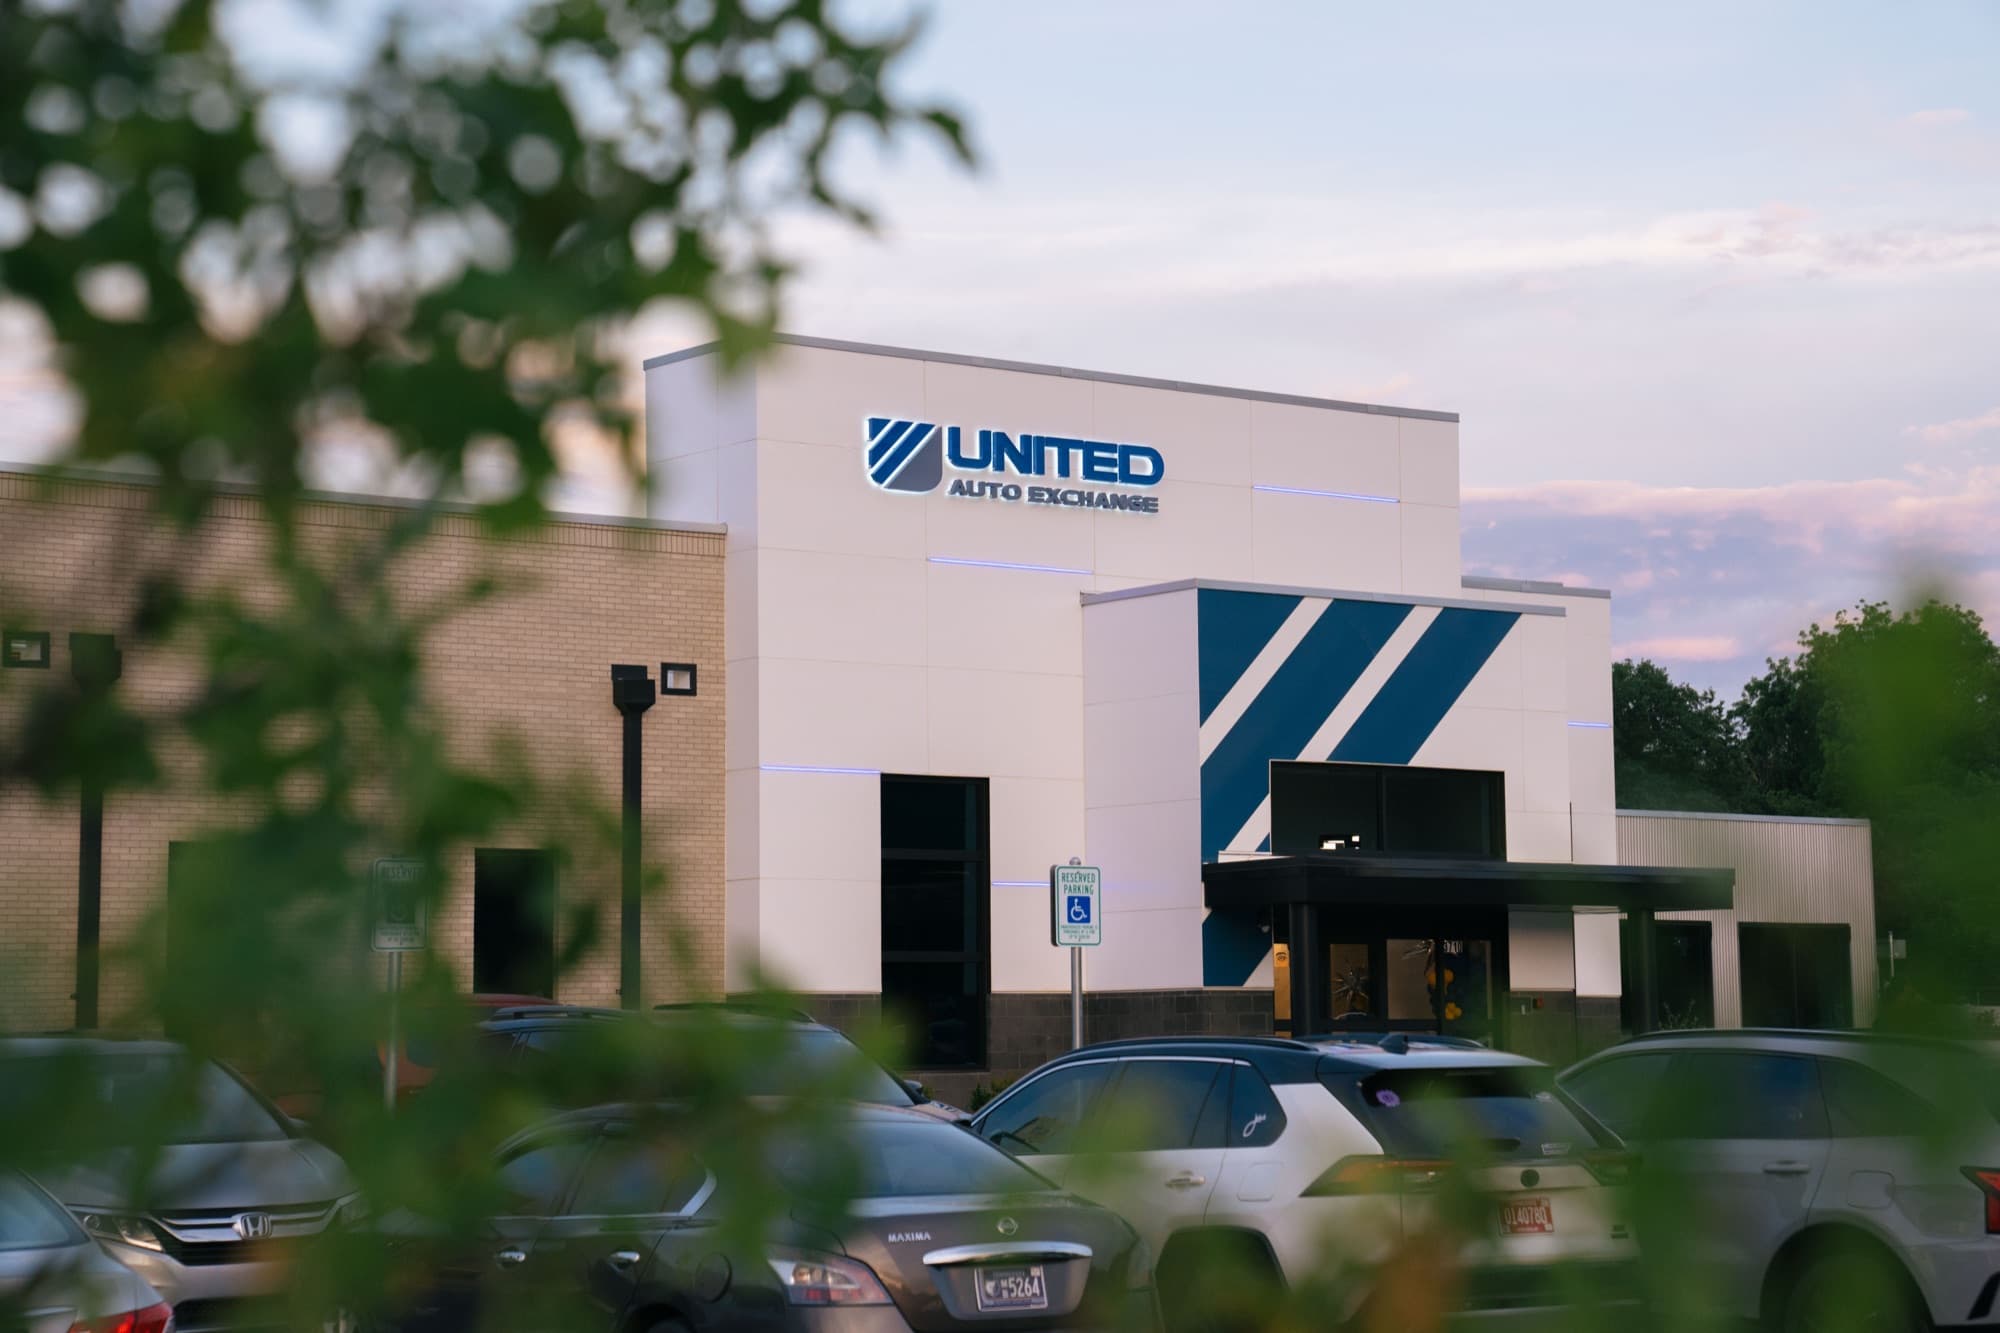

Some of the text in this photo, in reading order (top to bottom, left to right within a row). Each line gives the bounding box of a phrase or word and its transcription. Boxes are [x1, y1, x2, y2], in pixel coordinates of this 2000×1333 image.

[947, 426, 1164, 485] UNITED
[950, 479, 1159, 513] AUTO EXCHANGE
[1061, 872, 1095, 883] RESERVED
[1063, 884, 1094, 895] PARKING
[888, 1231, 931, 1242] MAXIMA
[1008, 1277, 1040, 1298] 5264
